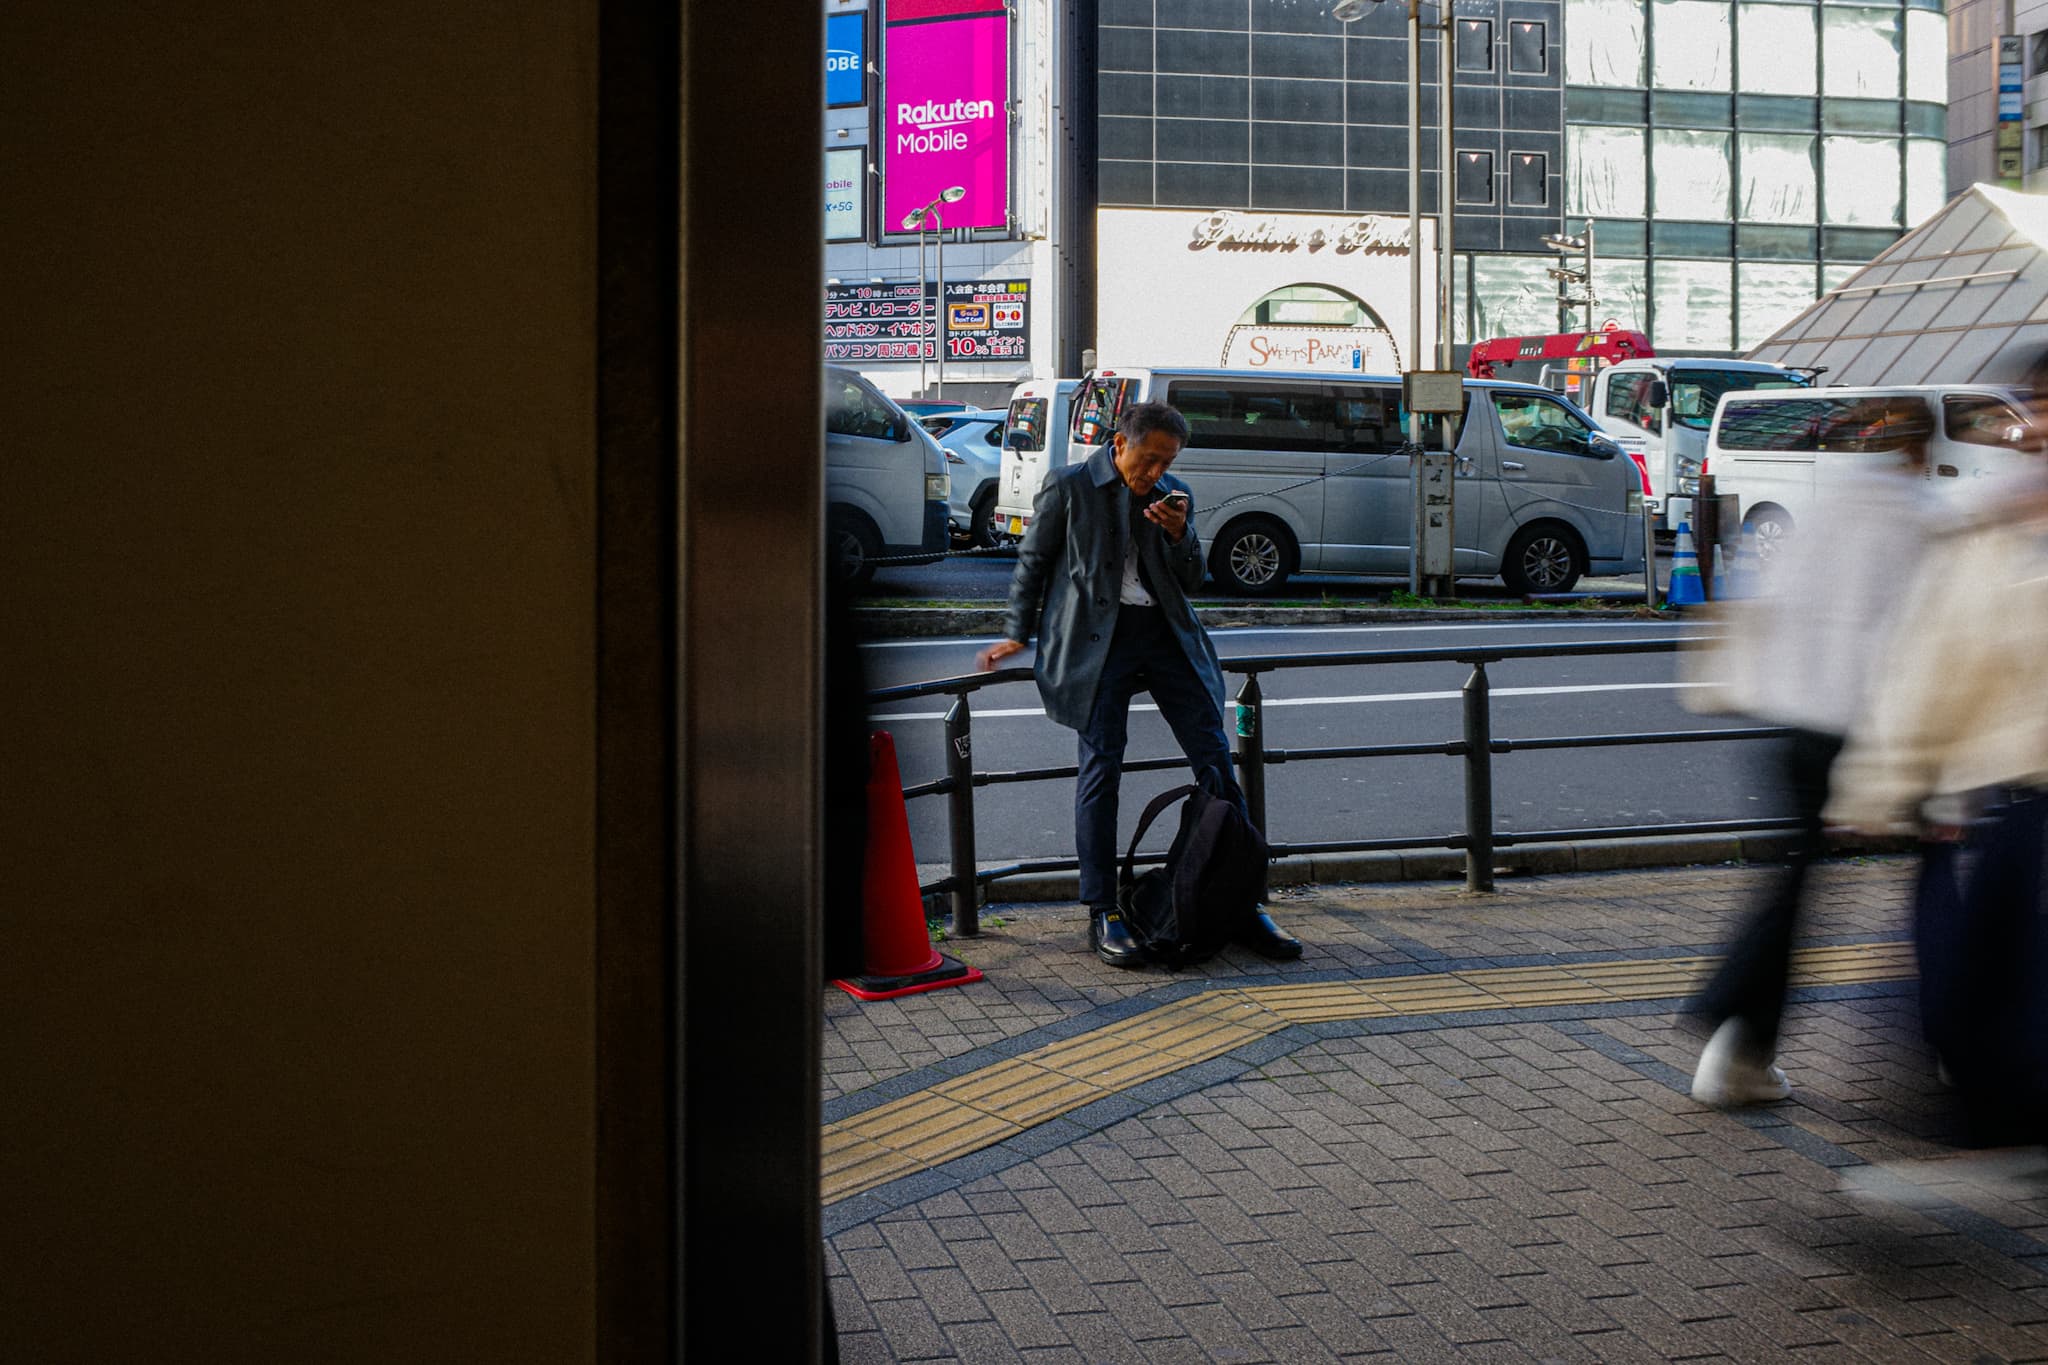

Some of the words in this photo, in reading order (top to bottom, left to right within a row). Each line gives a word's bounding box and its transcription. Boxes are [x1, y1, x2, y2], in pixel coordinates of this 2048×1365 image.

[897, 98, 994, 125] Rakuten
[897, 129, 968, 154] Mobile
[825, 342, 935, 358] パソコン周辺機器
[947, 337, 990, 355] 10%
